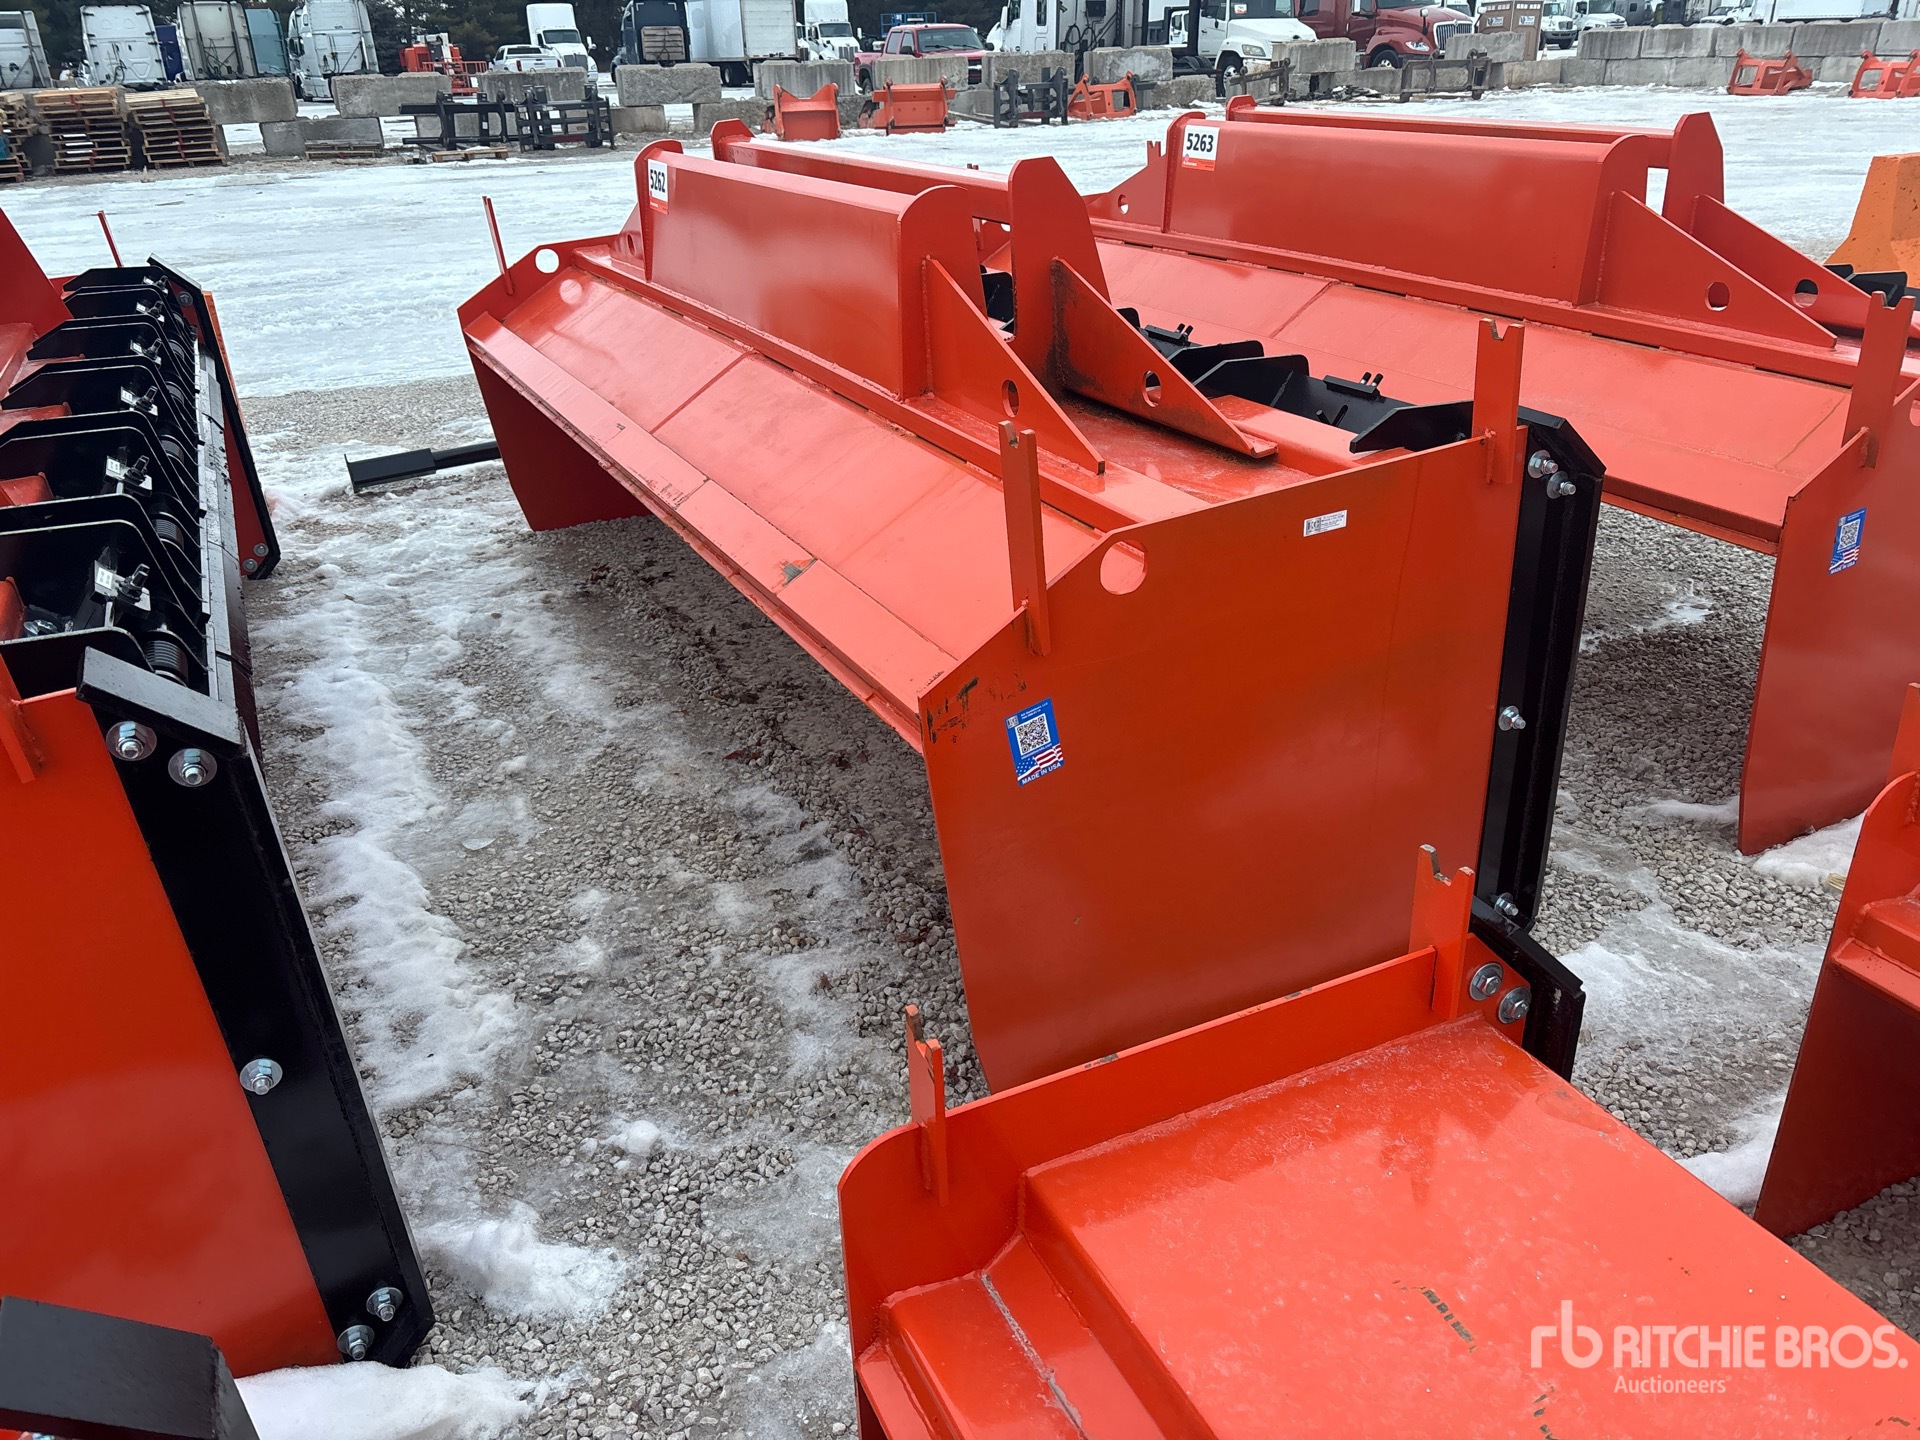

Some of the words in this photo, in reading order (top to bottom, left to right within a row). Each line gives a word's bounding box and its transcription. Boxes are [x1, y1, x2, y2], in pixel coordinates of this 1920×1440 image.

[1186, 132, 1214, 153] 5263
[650, 168, 666, 194] 5262
[1021, 770, 1040, 785] MADE
[1040, 767, 1048, 776] IN
[1048, 762, 1062, 772] USA
